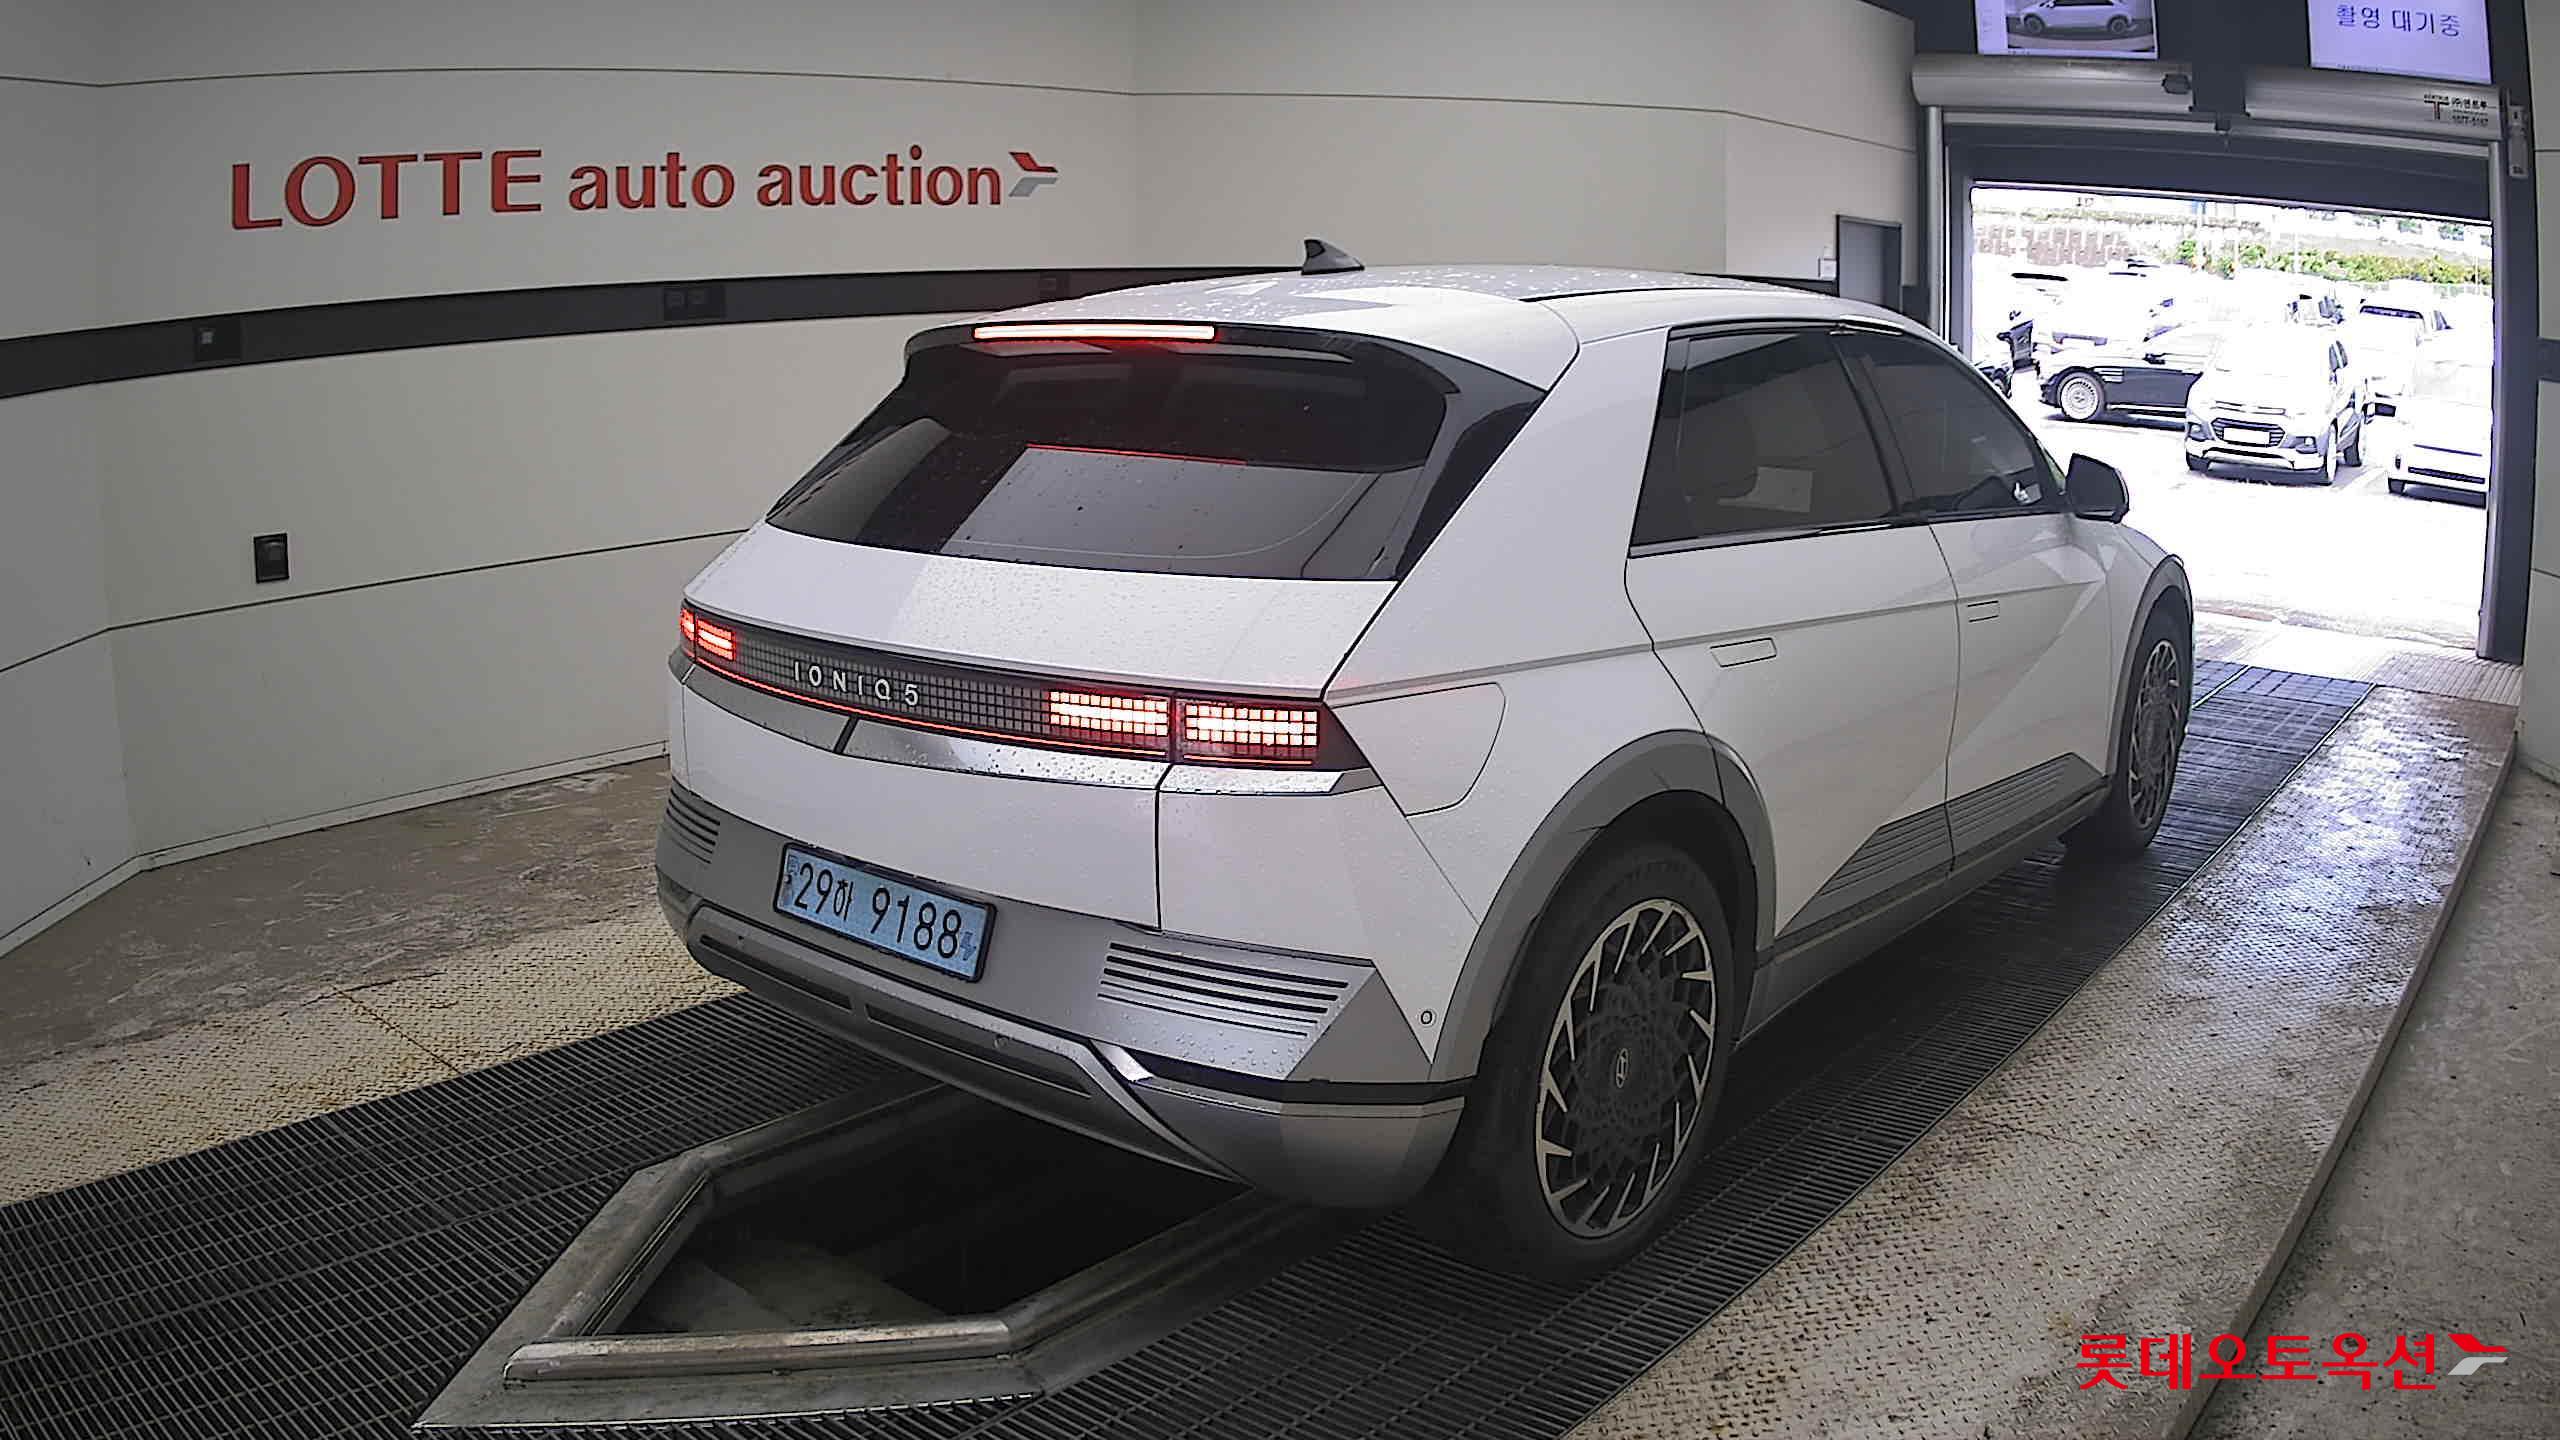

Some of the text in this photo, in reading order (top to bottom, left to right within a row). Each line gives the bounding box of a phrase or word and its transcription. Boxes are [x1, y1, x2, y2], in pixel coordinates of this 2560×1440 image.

[2337, 4, 2461, 38] 촬영 대기중
[231, 144, 1002, 231] LOTTE auto auction
[793, 660, 919, 707] IONIQ 5
[794, 862, 963, 960] 29하 9188
